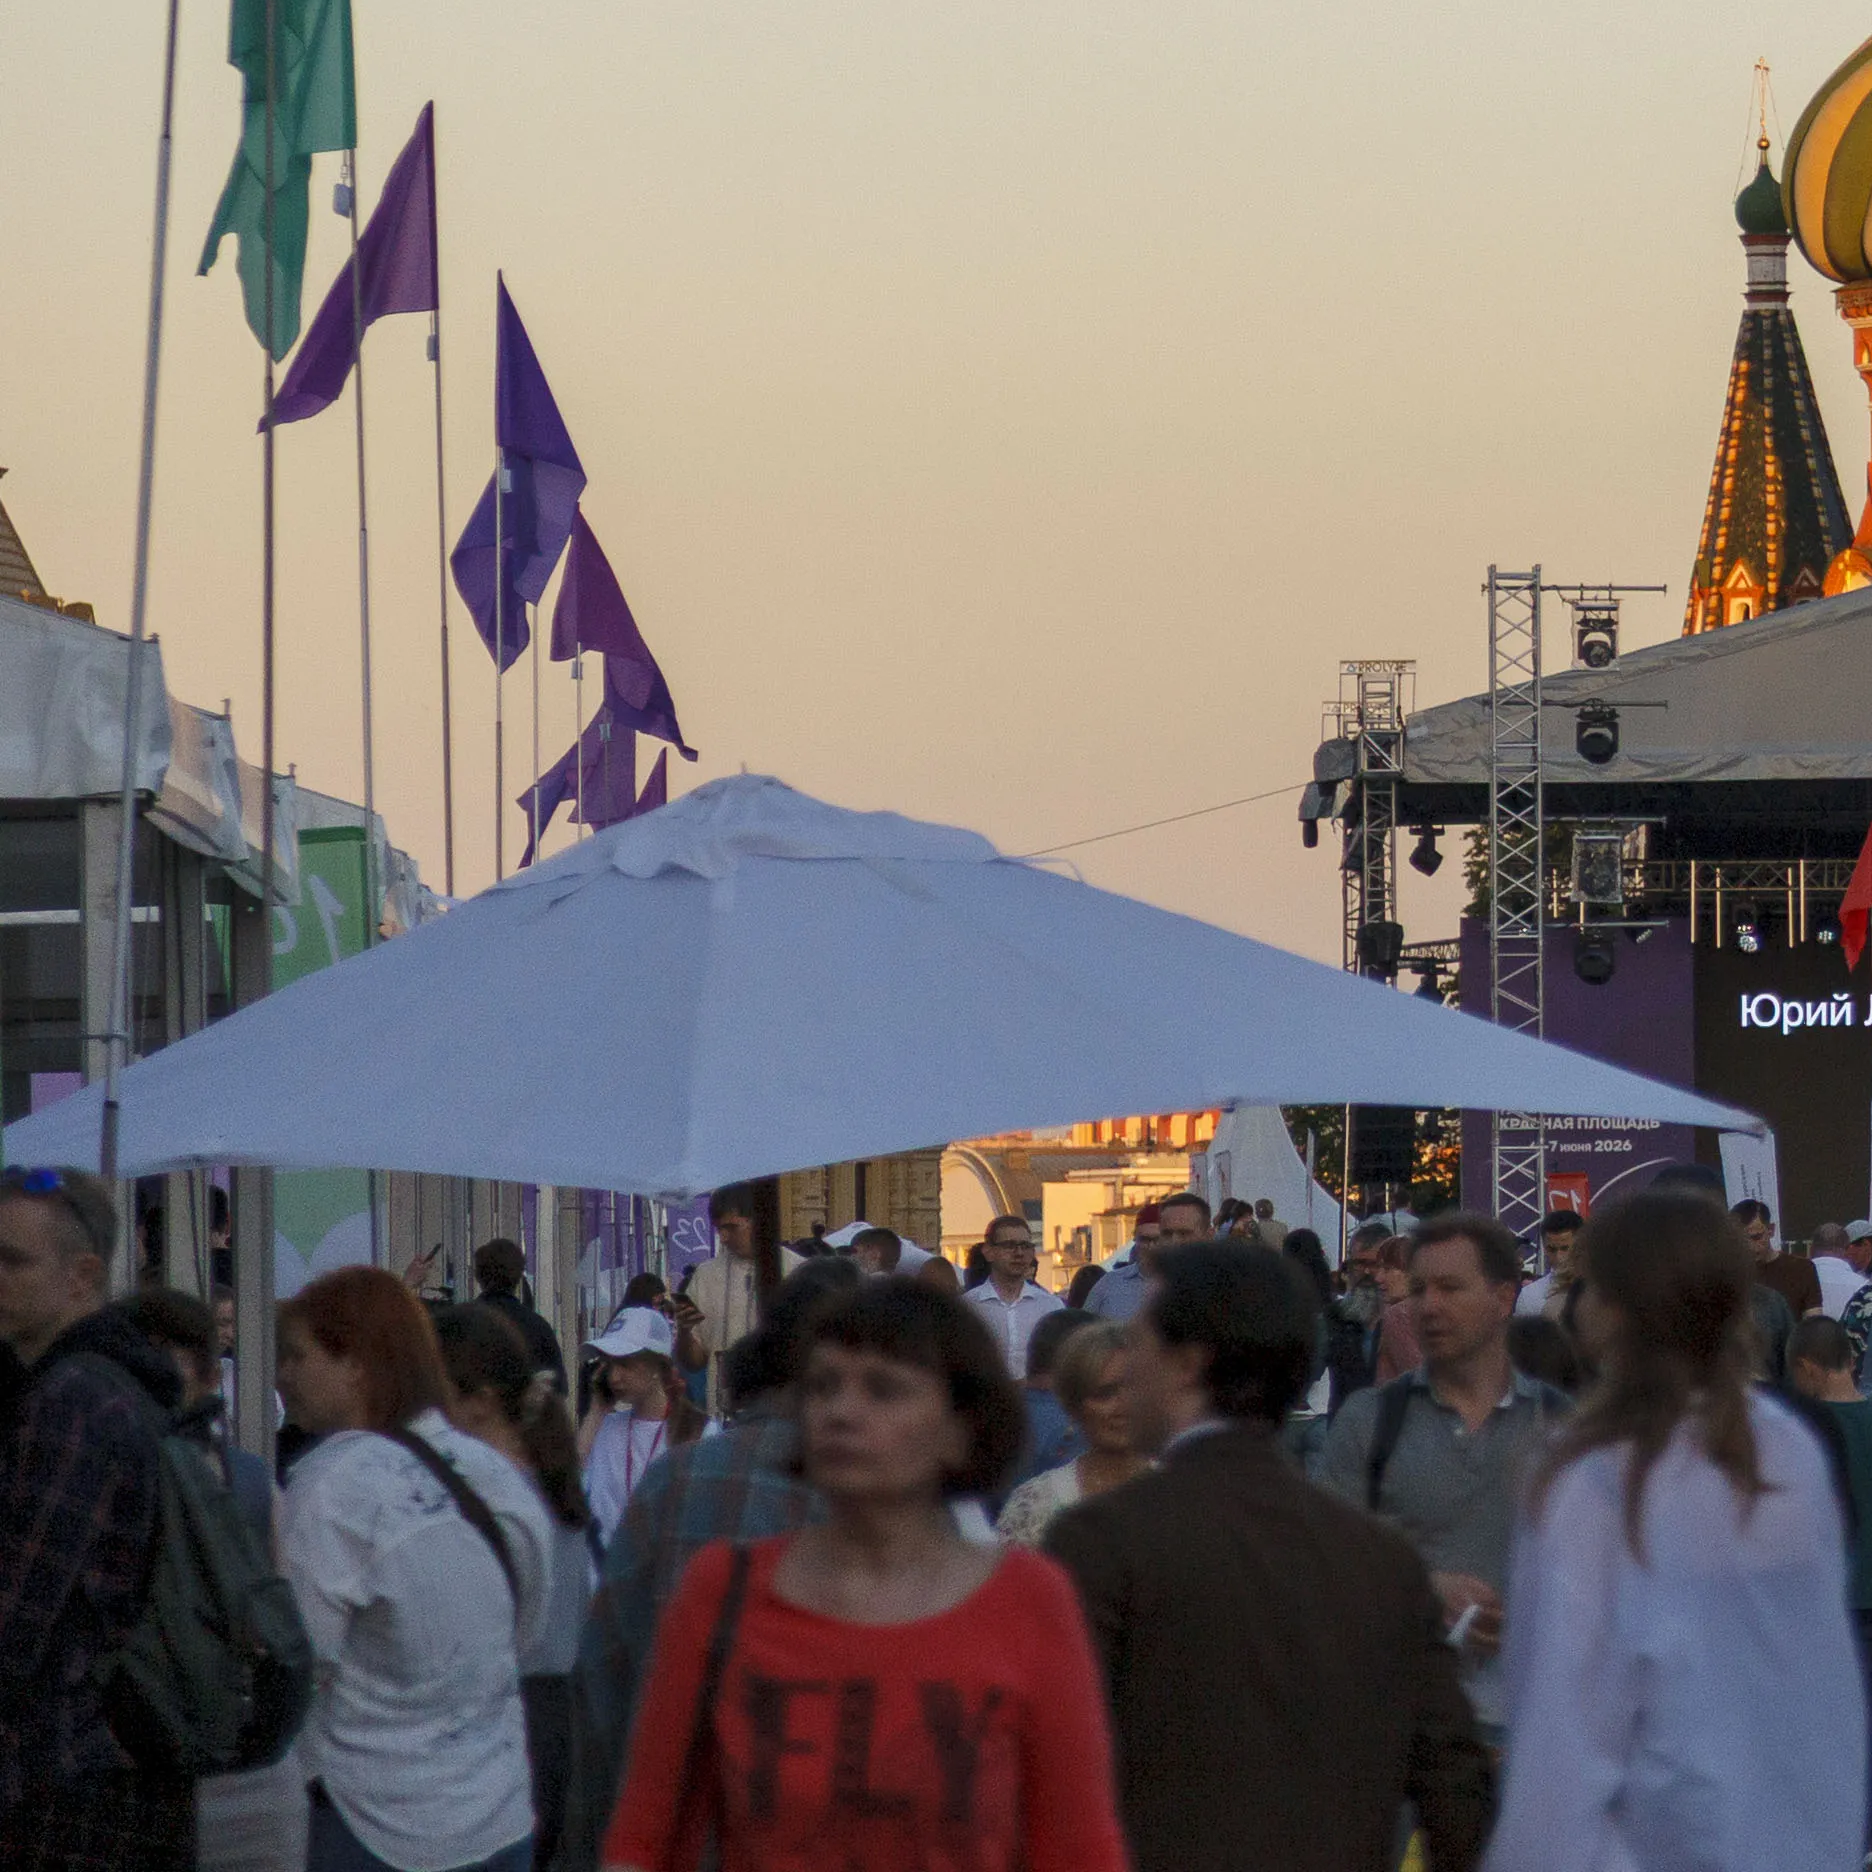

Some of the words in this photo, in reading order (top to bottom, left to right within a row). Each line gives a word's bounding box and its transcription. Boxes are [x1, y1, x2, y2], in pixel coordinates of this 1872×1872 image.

[1740, 993, 1851, 1036] Юрий
[1577, 1117, 1661, 1132] ПЛОЩАДЬ
[1560, 1142, 1591, 1153] июня
[1594, 1139, 1633, 1152] 2026
[743, 1672, 1006, 1822] FLY
